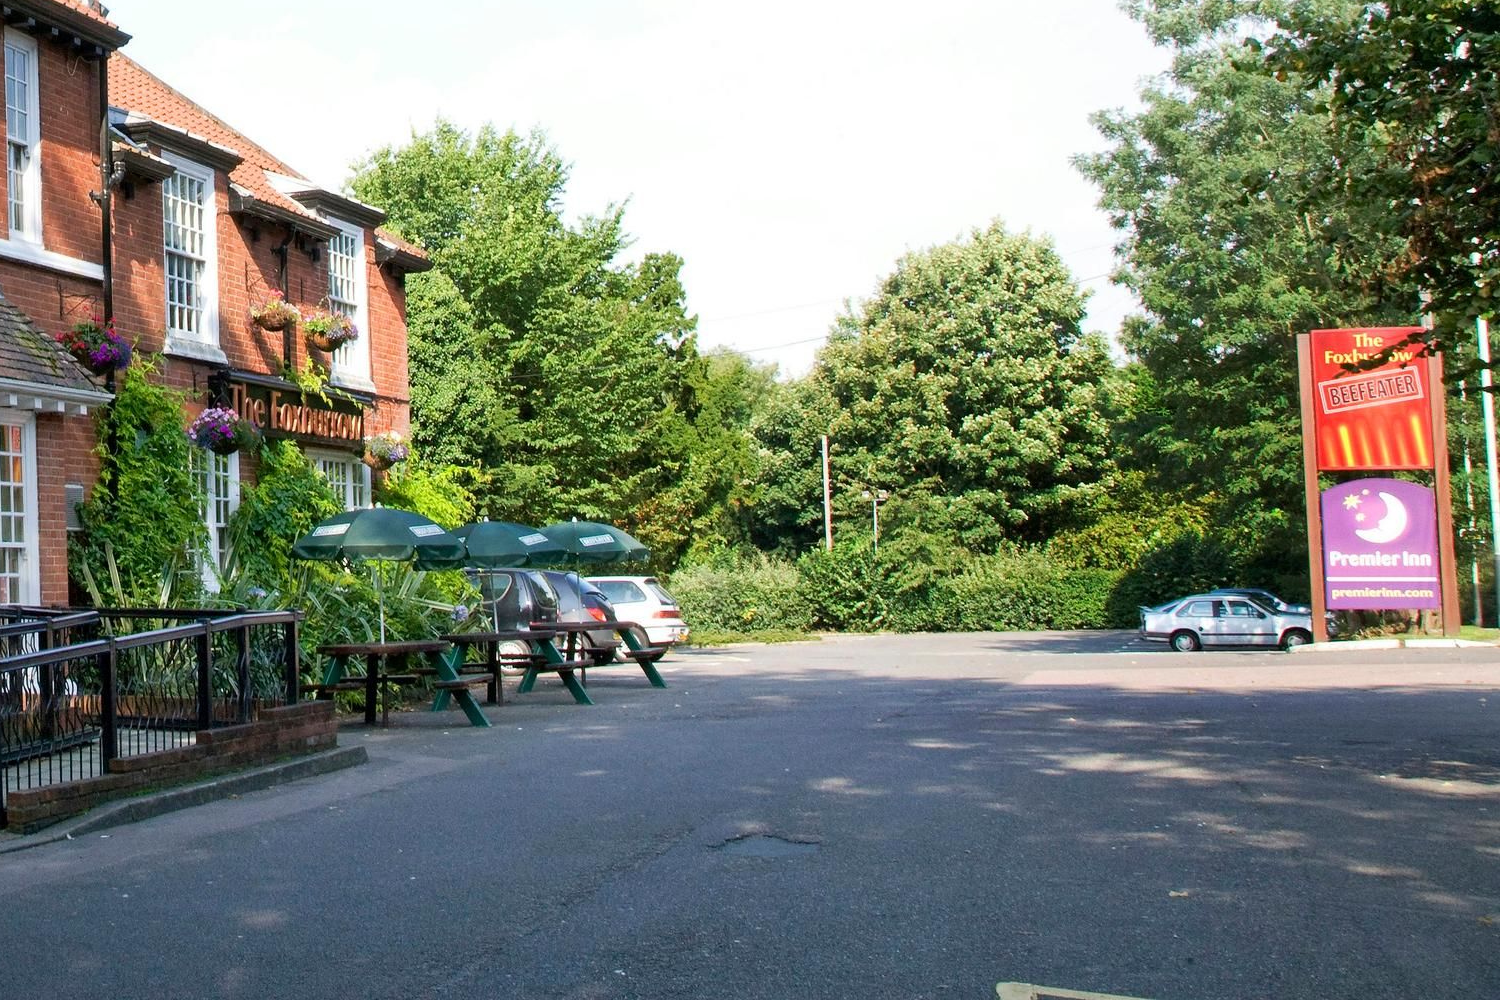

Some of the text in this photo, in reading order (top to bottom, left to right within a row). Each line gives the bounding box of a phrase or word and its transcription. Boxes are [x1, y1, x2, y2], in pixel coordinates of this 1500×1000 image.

[1353, 332, 1383, 347] The
[1324, 349, 1413, 364] Foxbow
[1329, 375, 1415, 406] BEEFEATER
[229, 383, 362, 440] The Foxburrow
[1329, 550, 1431, 567] Premier Inn
[1331, 587, 1434, 600] premierinn.com
